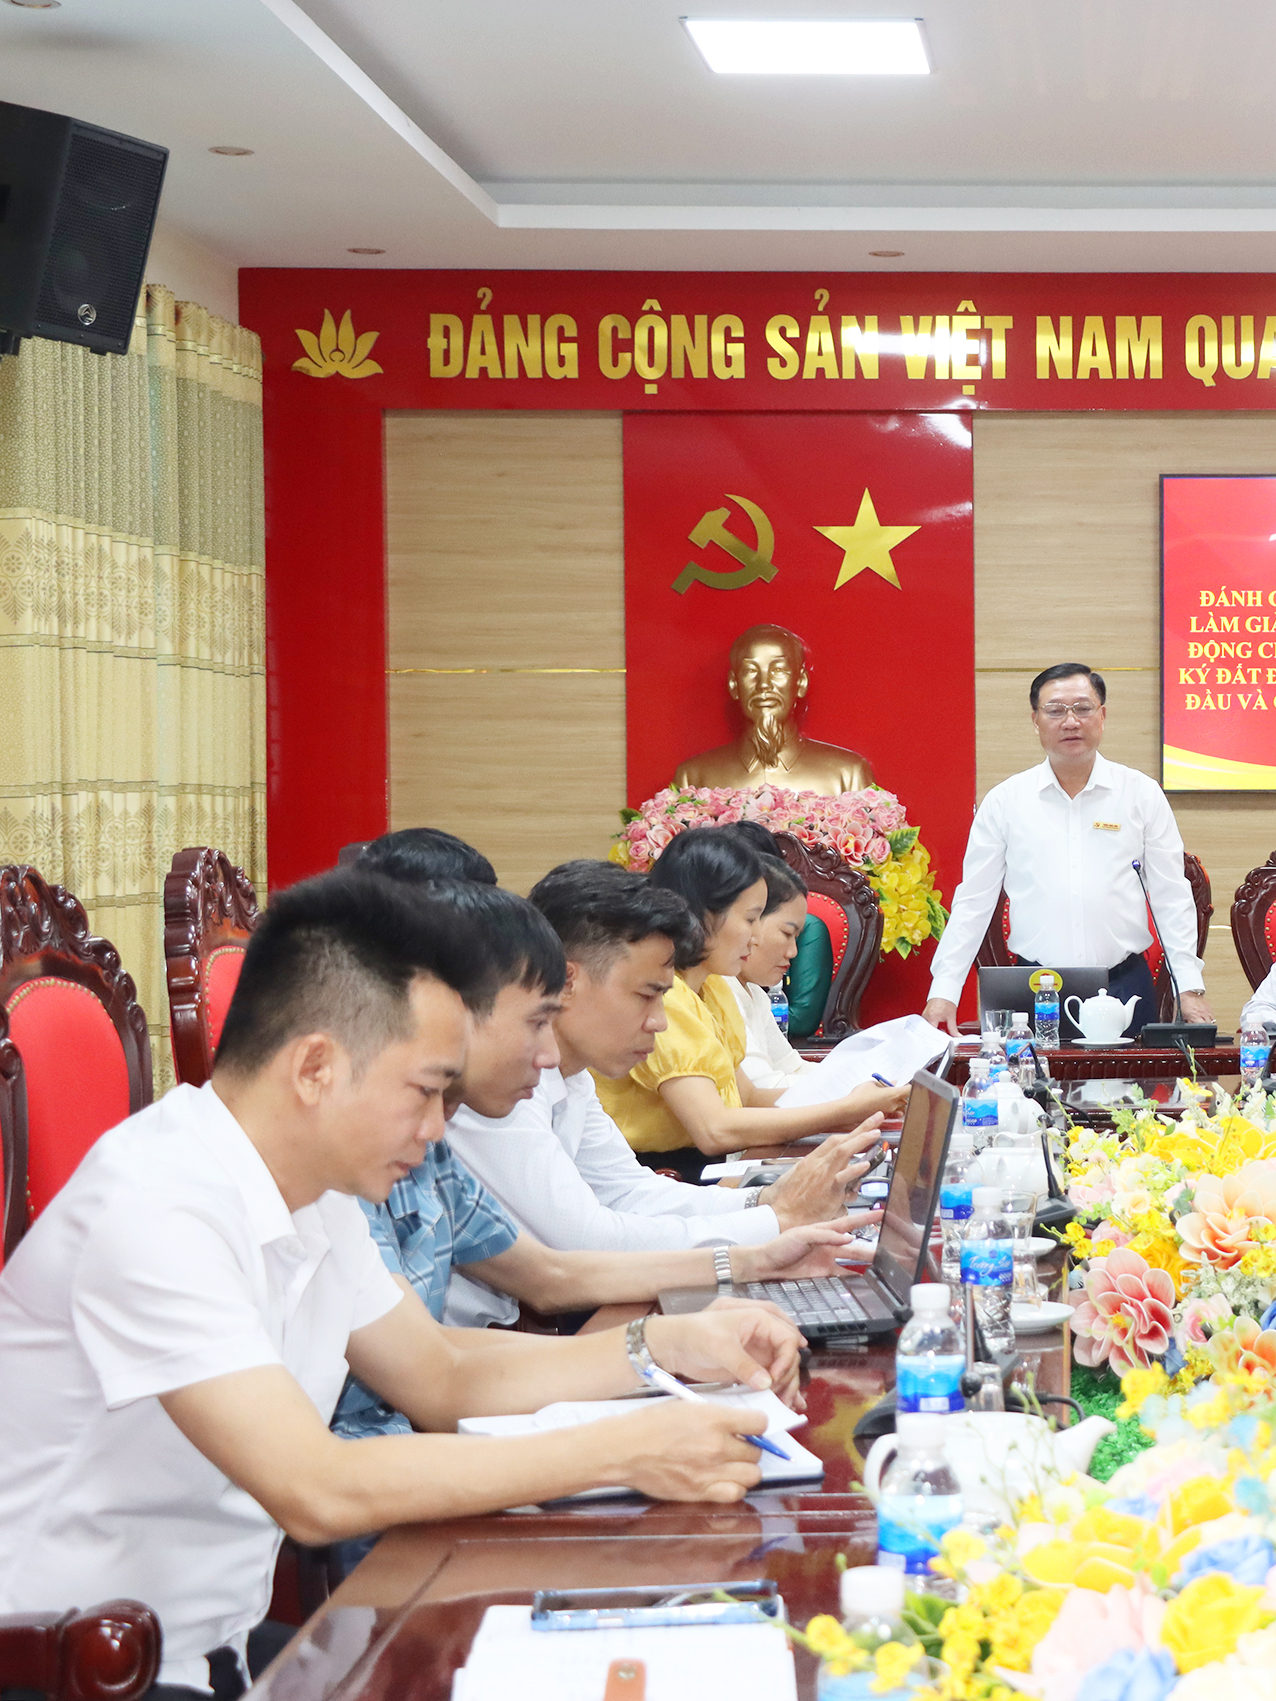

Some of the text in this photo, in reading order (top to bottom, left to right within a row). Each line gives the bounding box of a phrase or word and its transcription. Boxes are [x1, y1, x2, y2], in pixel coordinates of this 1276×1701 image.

[427, 287, 579, 380] ĐẢNG
[599, 298, 745, 395] CỘNG
[765, 288, 880, 380] SẢN
[900, 300, 1014, 396] VIỆT
[1035, 315, 1164, 380] NAM
[1199, 585, 1263, 607] ĐÁNH
[1190, 611, 1240, 633] LÀM
[1187, 639, 1253, 665] ĐỘNG
[1178, 663, 1211, 685] KÝ
[1215, 662, 1262, 685] ĐẤT
[1185, 688, 1232, 711] ĐẦU
[1236, 688, 1269, 711] VÀ
